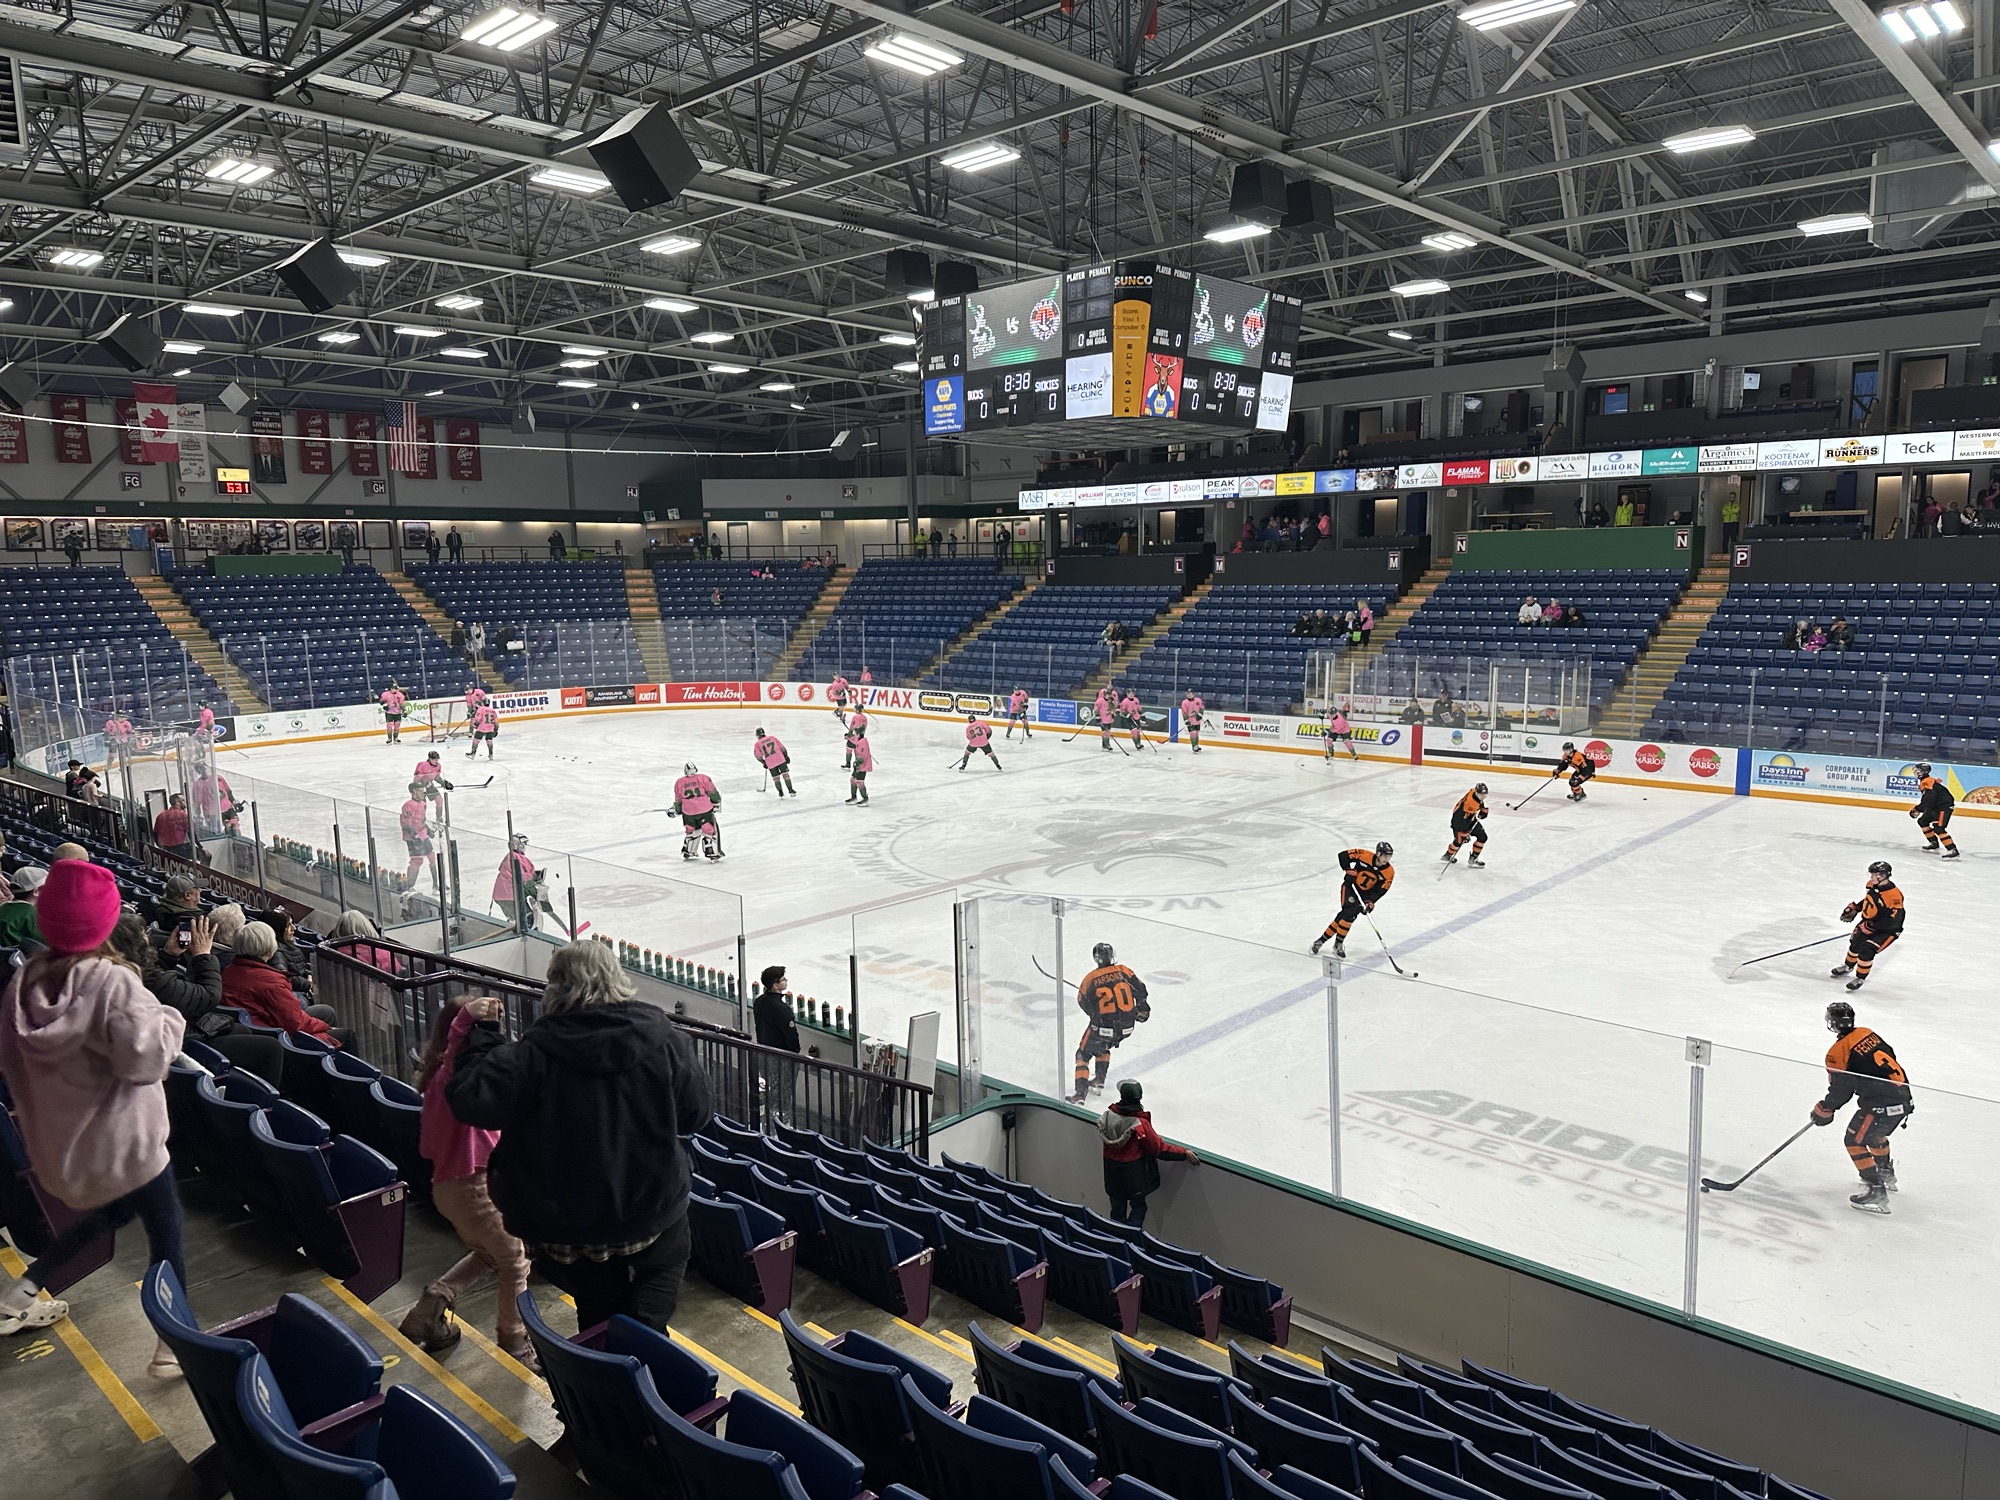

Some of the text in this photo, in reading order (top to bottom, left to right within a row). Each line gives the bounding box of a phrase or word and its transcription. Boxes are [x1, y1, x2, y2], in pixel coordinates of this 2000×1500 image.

[1066, 266, 1112, 282] PLAYER PENALTY
[1155, 264, 1192, 280] PLAYER PENALTY
[1114, 275, 1153, 285] SUNCO
[923, 297, 961, 310] PLAYER PENALTY
[1271, 292, 1302, 307] PLAYER PENALTY
[1088, 328, 1105, 337] SHOTS
[1155, 328, 1169, 337] SHOTS
[1078, 333, 1084, 347] 0
[1085, 336, 1107, 346] ON GOAL
[1152, 335, 1170, 346] ON GOAL
[1175, 333, 1182, 348] 0
[953, 354, 959, 367] 0
[1271, 351, 1277, 364] 0
[928, 363, 936, 371] ON
[1004, 372, 1031, 392] 8:38
[1067, 380, 1103, 393] HEARING
[1214, 371, 1237, 391] 8:38
[967, 389, 984, 401] BUCKS
[1080, 389, 1103, 399] CLINIC
[1048, 393, 1057, 411] 0
[1191, 393, 1199, 410] 0
[1261, 397, 1284, 407] HEARING
[980, 402, 988, 419] 0
[1013, 404, 1017, 415] 1
[1218, 403, 1222, 414] 1
[1244, 400, 1251, 417] 0
[1701, 446, 1755, 460] Argamech
[1826, 446, 1879, 459] RUNNERS
[1902, 441, 1936, 454] Teck
[1764, 452, 1805, 460] KOOTENAY
[1592, 463, 1640, 472] BIGHORN
[1759, 459, 1815, 468] RESPIRATORY
[1447, 467, 1481, 475] FLAMAN
[125, 476, 140, 487] FG
[373, 483, 385, 493] GH
[627, 488, 638, 497] HJ
[844, 488, 853, 497] JK
[1457, 541, 1466, 552] N
[1677, 535, 1687, 547] N
[1390, 557, 1399, 567] M
[1737, 552, 1747, 564] P
[1048, 563, 1053, 573] L
[1176, 561, 1182, 571] L
[1216, 561, 1224, 571] M
[638, 693, 657, 701] KIOTI
[682, 686, 746, 699] Tim Hortons
[492, 697, 549, 709] LIQUOR
[564, 697, 583, 705] KIOTI
[850, 688, 912, 709] RE/MAX
[498, 706, 544, 714] WAREHOUSE
[485, 714, 495, 724] 12
[1223, 722, 1249, 730] ROYAL
[1349, 727, 1379, 740] TIRE
[761, 742, 776, 757] 17
[1761, 766, 1804, 775] Days Inn
[1825, 765, 1864, 775] CORPORATE
[1889, 776, 1917, 786] Days
[684, 787, 701, 799] 21
[1359, 872, 1375, 888] T
[1093, 972, 1123, 986] PARSONS
[1096, 982, 1134, 1014] 20
[1853, 1034, 1881, 1056] FECTEAU
[1873, 1050, 1905, 1087] 3
[389, 1190, 396, 1202] 8
[784, 1239, 790, 1248] 6
[1038, 1268, 1043, 1276] 4
